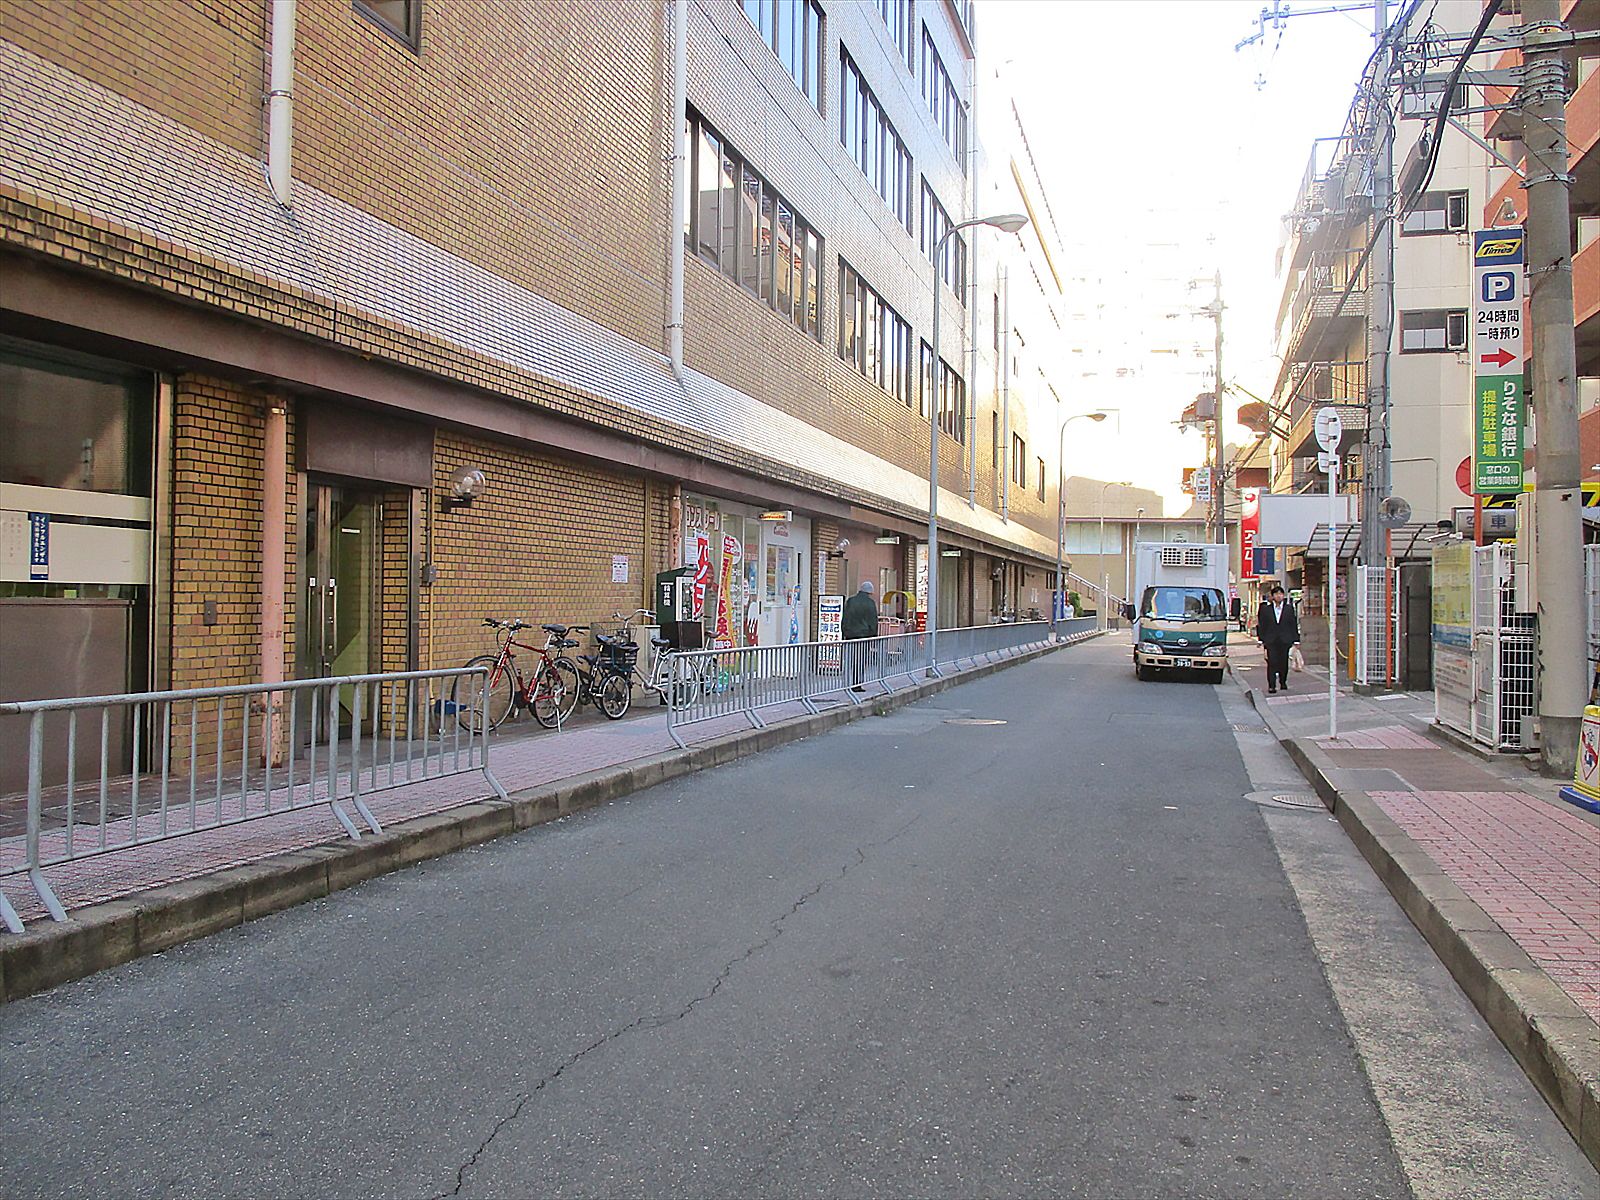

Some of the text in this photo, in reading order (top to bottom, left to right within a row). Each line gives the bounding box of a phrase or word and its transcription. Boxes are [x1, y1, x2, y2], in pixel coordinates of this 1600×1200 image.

[1482, 242, 1516, 256] Times
[1487, 276, 1511, 300] P
[1478, 309, 1520, 324] 24時間
[1477, 326, 1520, 340] 一時預り
[1482, 390, 1497, 457] 提携駐車場
[1501, 381, 1517, 457] りそな銀行
[1486, 465, 1511, 475] 窓口の
[820, 612, 840, 623] 宅建
